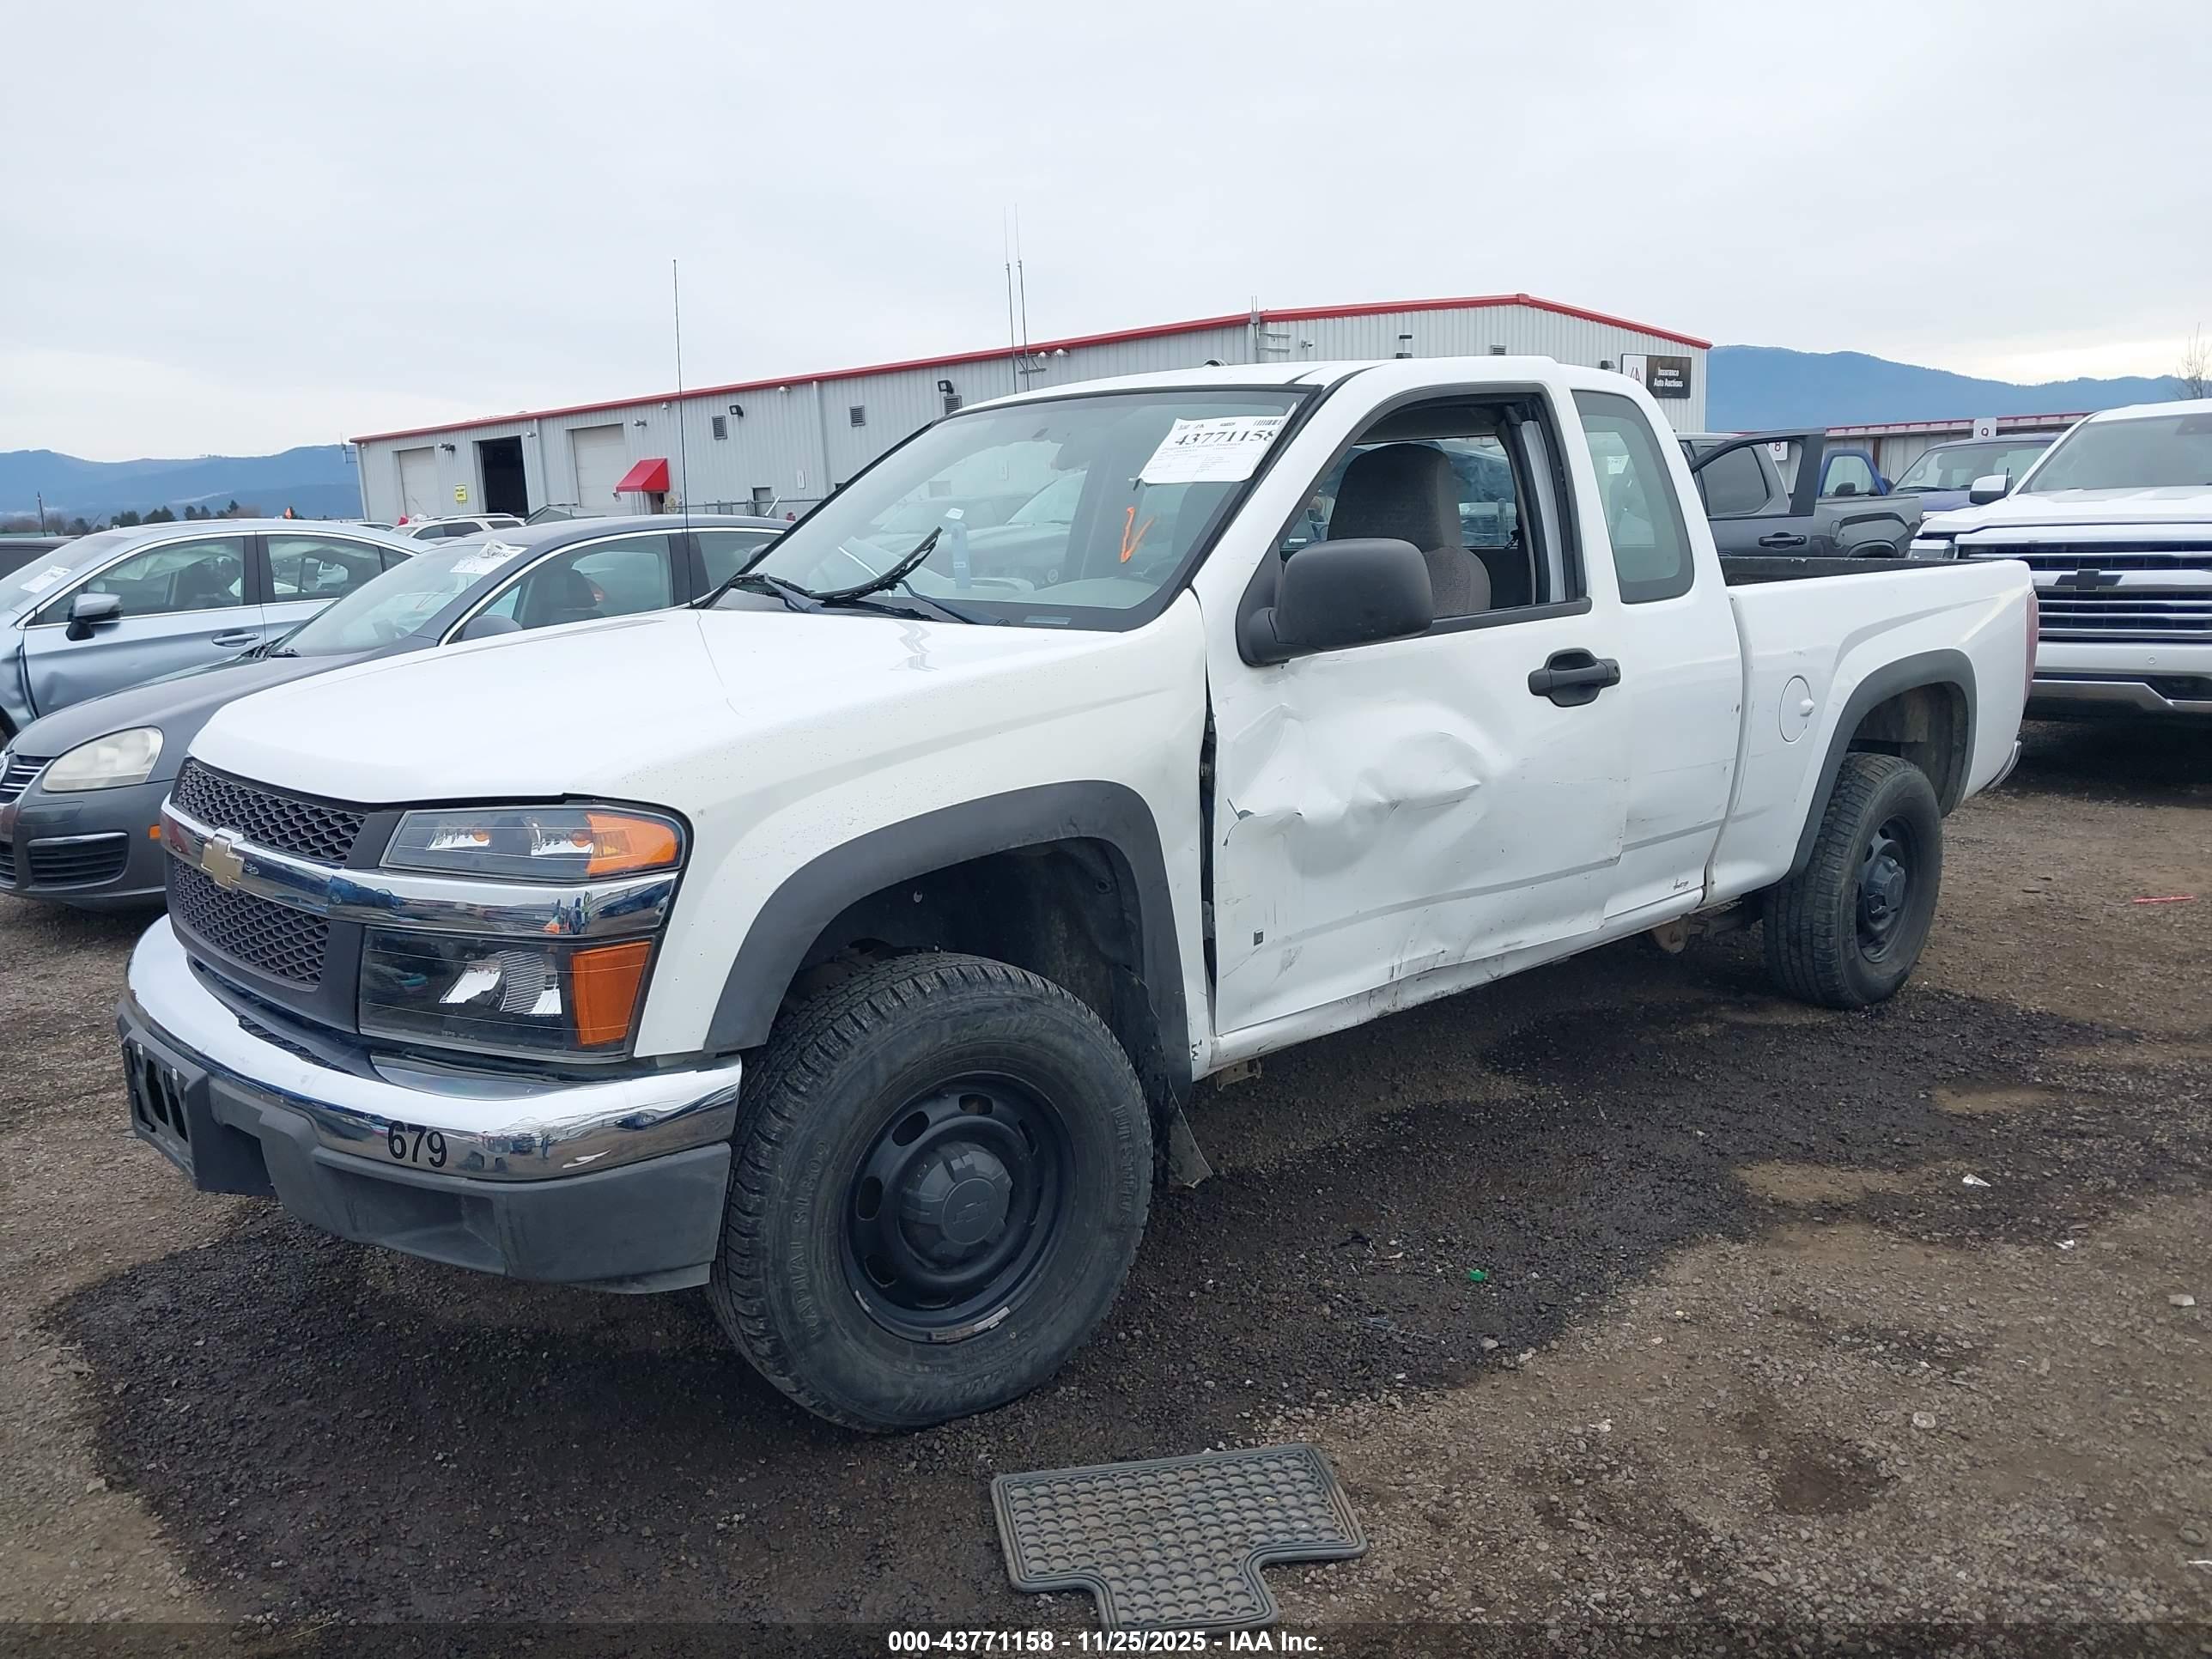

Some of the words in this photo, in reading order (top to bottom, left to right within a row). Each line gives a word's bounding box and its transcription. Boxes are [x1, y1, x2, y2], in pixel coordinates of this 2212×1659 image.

[1658, 368, 1680, 376] Insurance
[1665, 379, 1683, 387] Auctions
[1175, 429, 1275, 446] 43771158
[387, 1120, 447, 1168] 679
